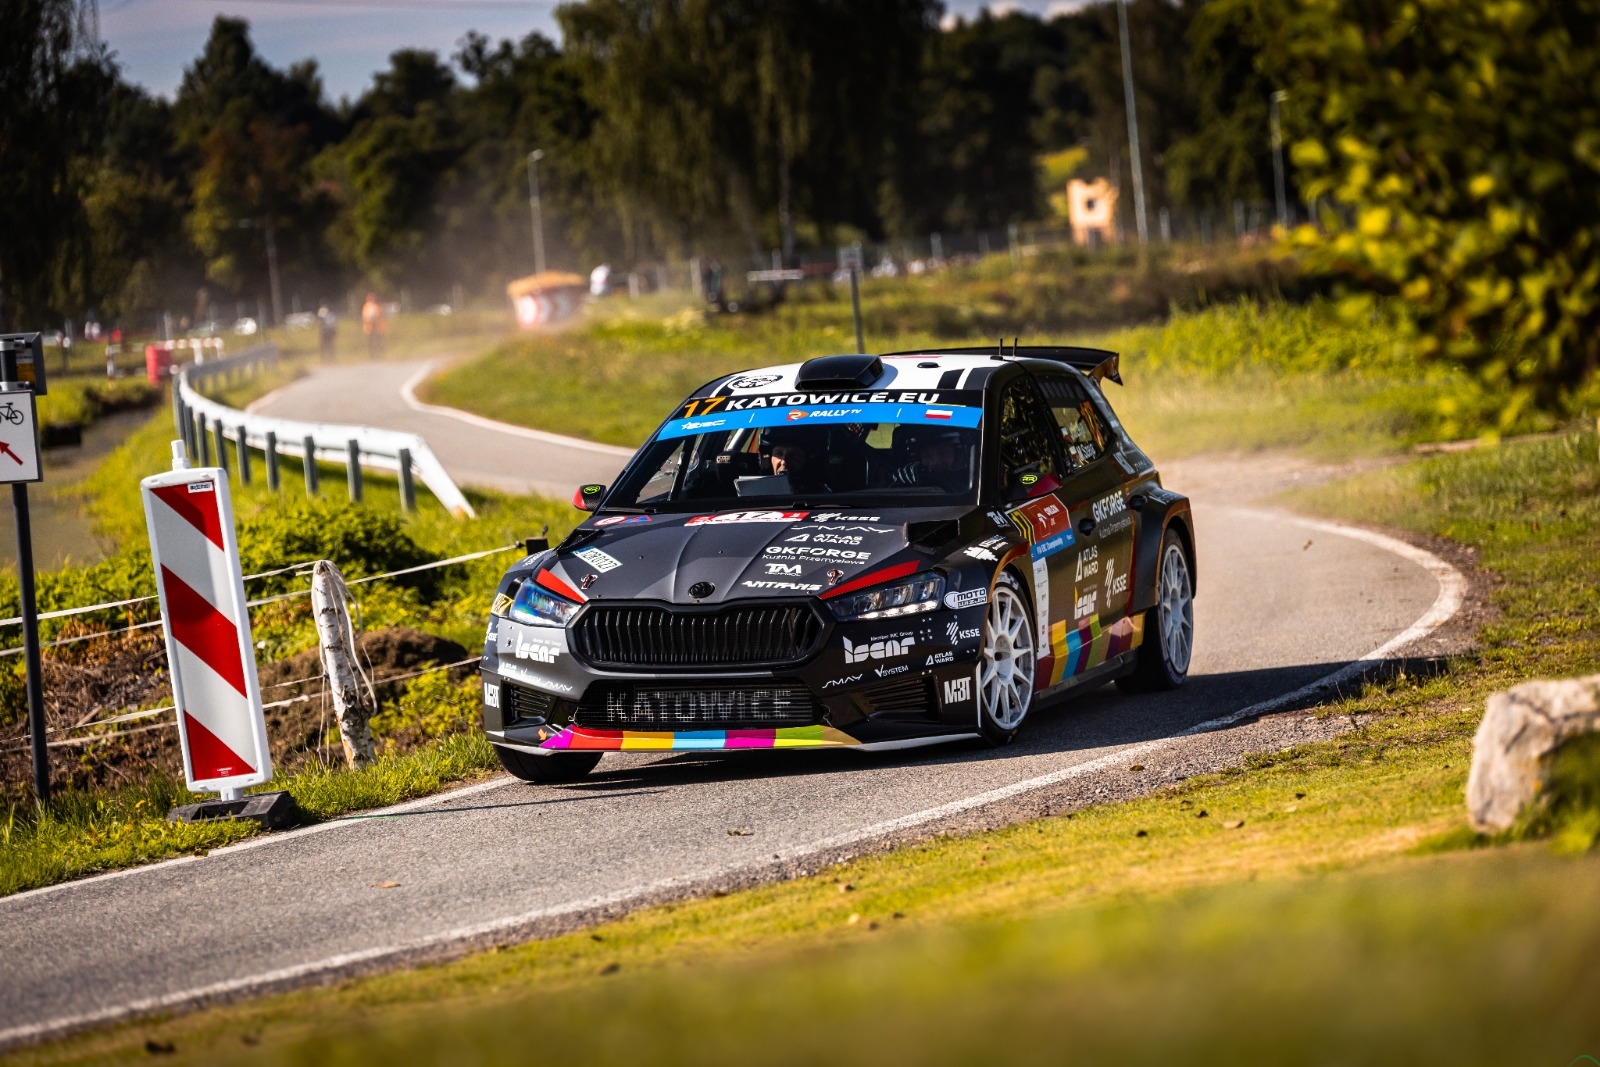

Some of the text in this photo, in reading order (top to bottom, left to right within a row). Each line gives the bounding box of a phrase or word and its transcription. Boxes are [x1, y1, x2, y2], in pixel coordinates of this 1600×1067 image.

[684, 392, 940, 418] 17 KATOWICE.EU
[809, 409, 851, 418] RALLY
[1092, 490, 1127, 522] GKFORGE
[813, 537, 861, 545] WARD
[815, 533, 863, 541] ATLAS
[766, 546, 872, 560] GKFORGE
[1082, 545, 1098, 562] ATLAS
[1083, 561, 1099, 578] WARD
[1112, 573, 1127, 596] KSSE
[957, 589, 986, 602] MOTO
[958, 628, 981, 639] KSSE
[934, 651, 953, 659] ATLAS
[935, 656, 955, 664] WARD
[944, 676, 972, 705] MBT
[606, 689, 791, 722] KATOWICE
